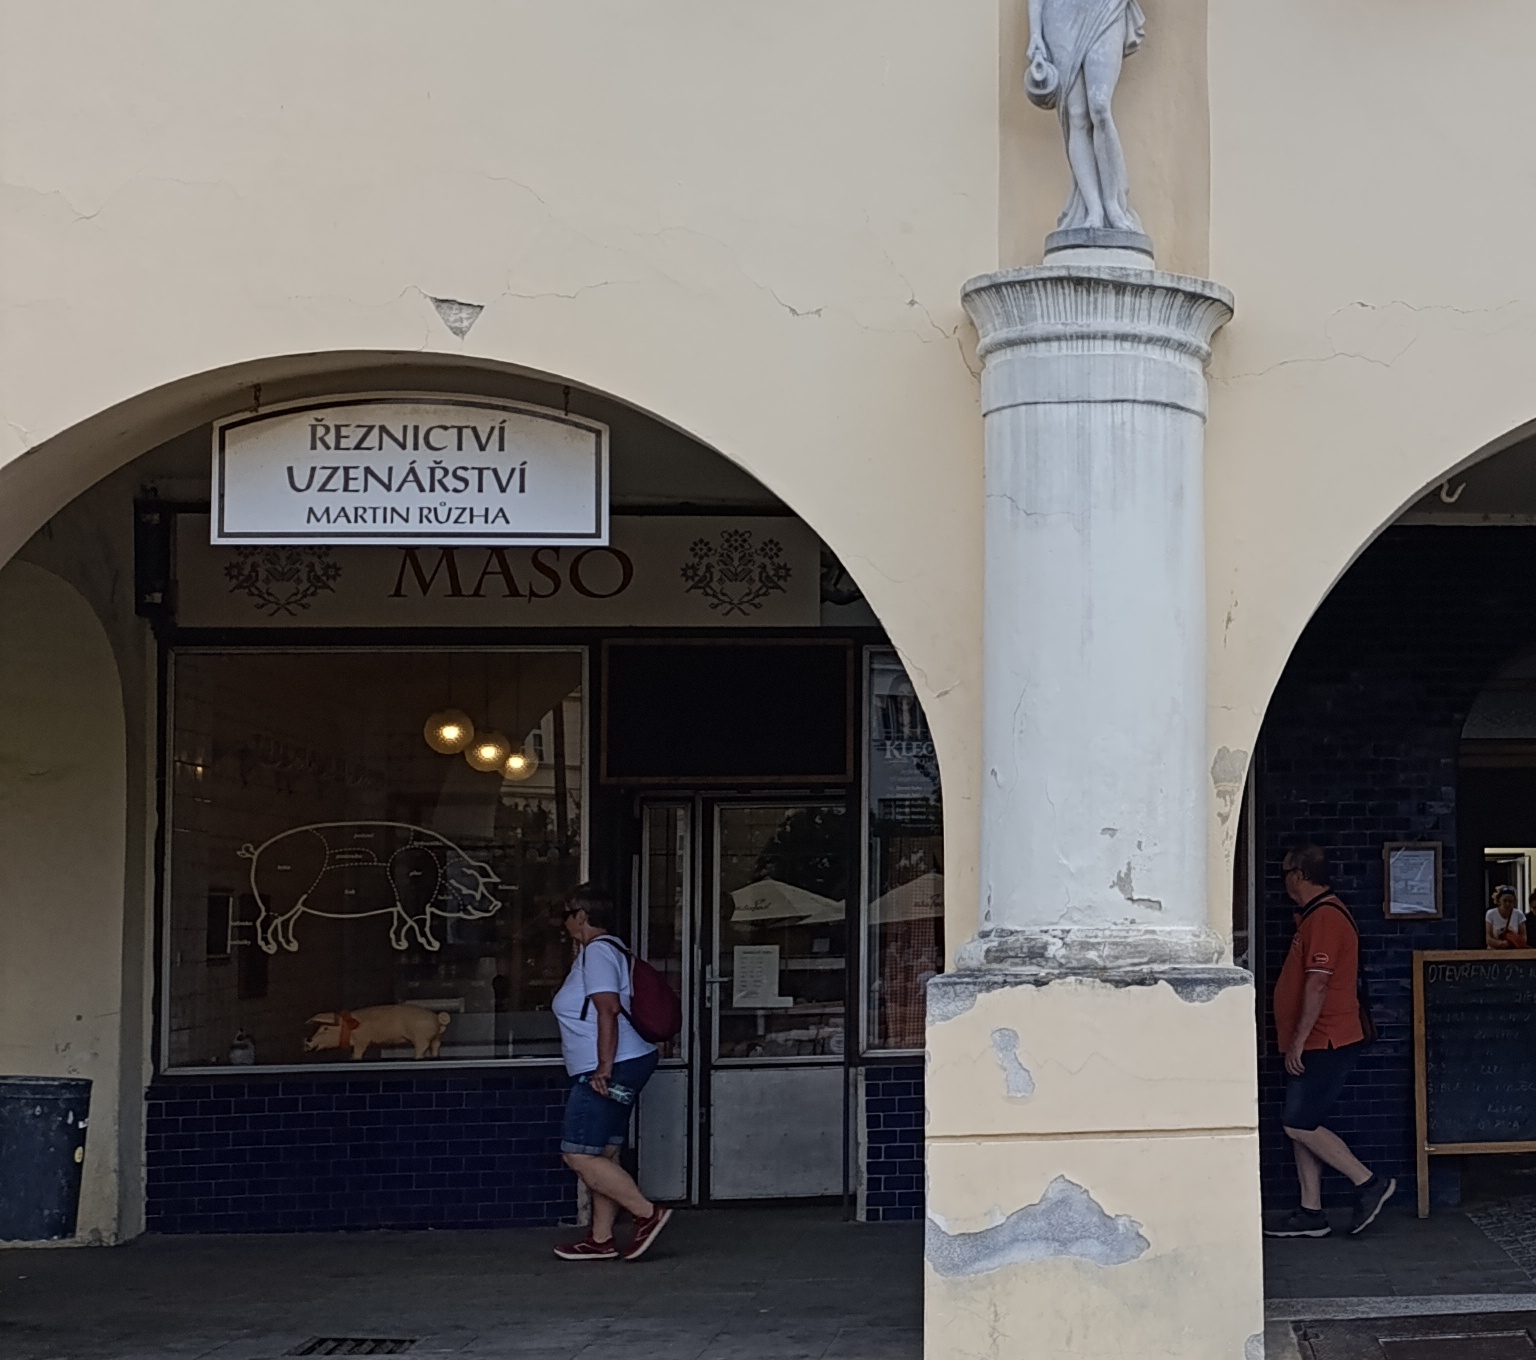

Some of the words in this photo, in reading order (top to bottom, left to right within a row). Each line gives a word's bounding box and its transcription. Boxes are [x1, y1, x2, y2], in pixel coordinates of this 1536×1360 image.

[308, 417, 507, 452] ŘEZNICTVÍ
[286, 459, 528, 493] UZENÁŘSTVÍ
[306, 506, 410, 524] MARTIN
[418, 501, 510, 524] RŮZHA
[387, 545, 634, 604] MASO
